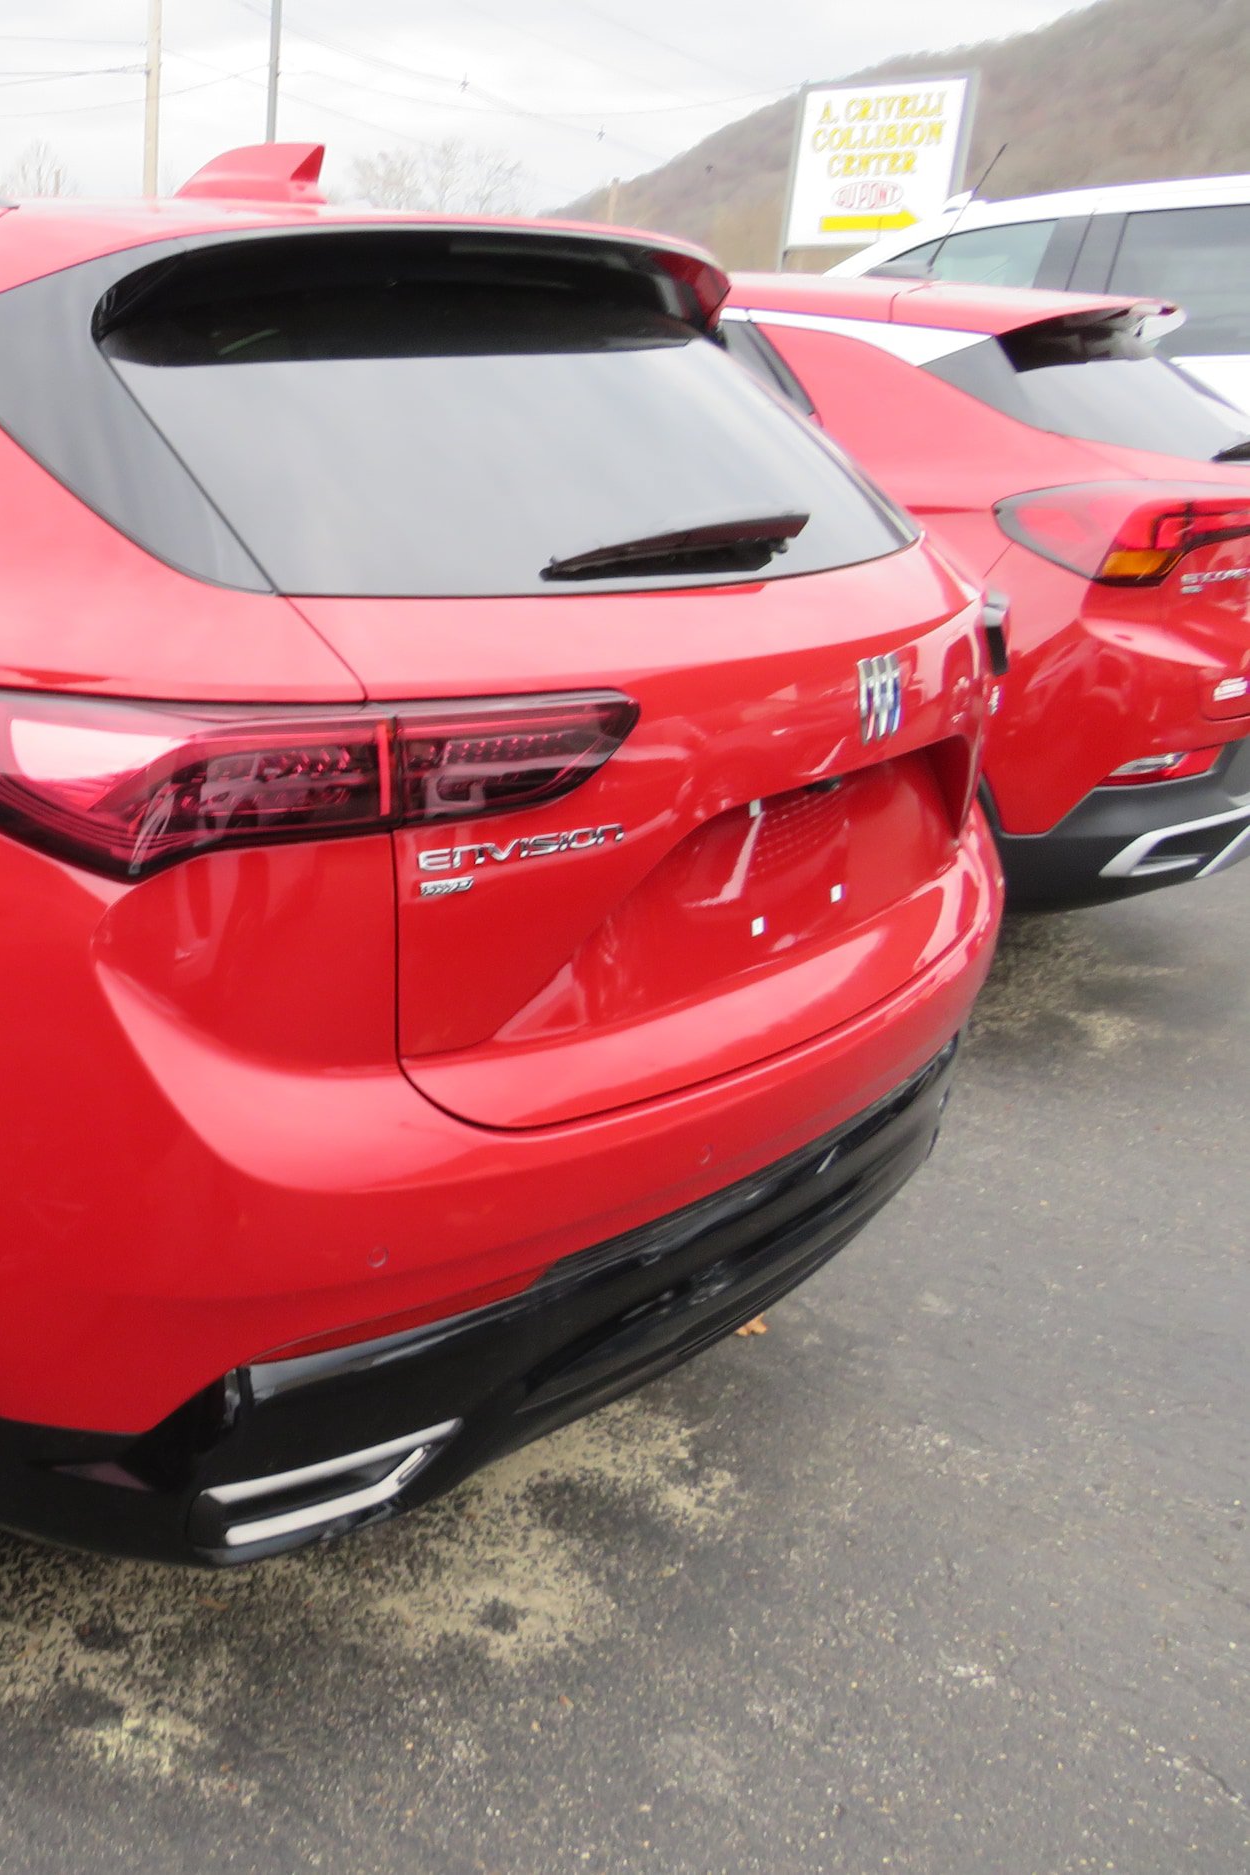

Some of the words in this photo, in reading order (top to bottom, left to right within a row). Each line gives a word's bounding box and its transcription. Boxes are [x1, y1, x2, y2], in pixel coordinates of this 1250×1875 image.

[818, 100, 839, 125] A.
[844, 91, 948, 122] CRIVELLI
[811, 120, 948, 153] COLLISION
[827, 151, 918, 179] CENTER
[418, 823, 625, 872] ENVISION
